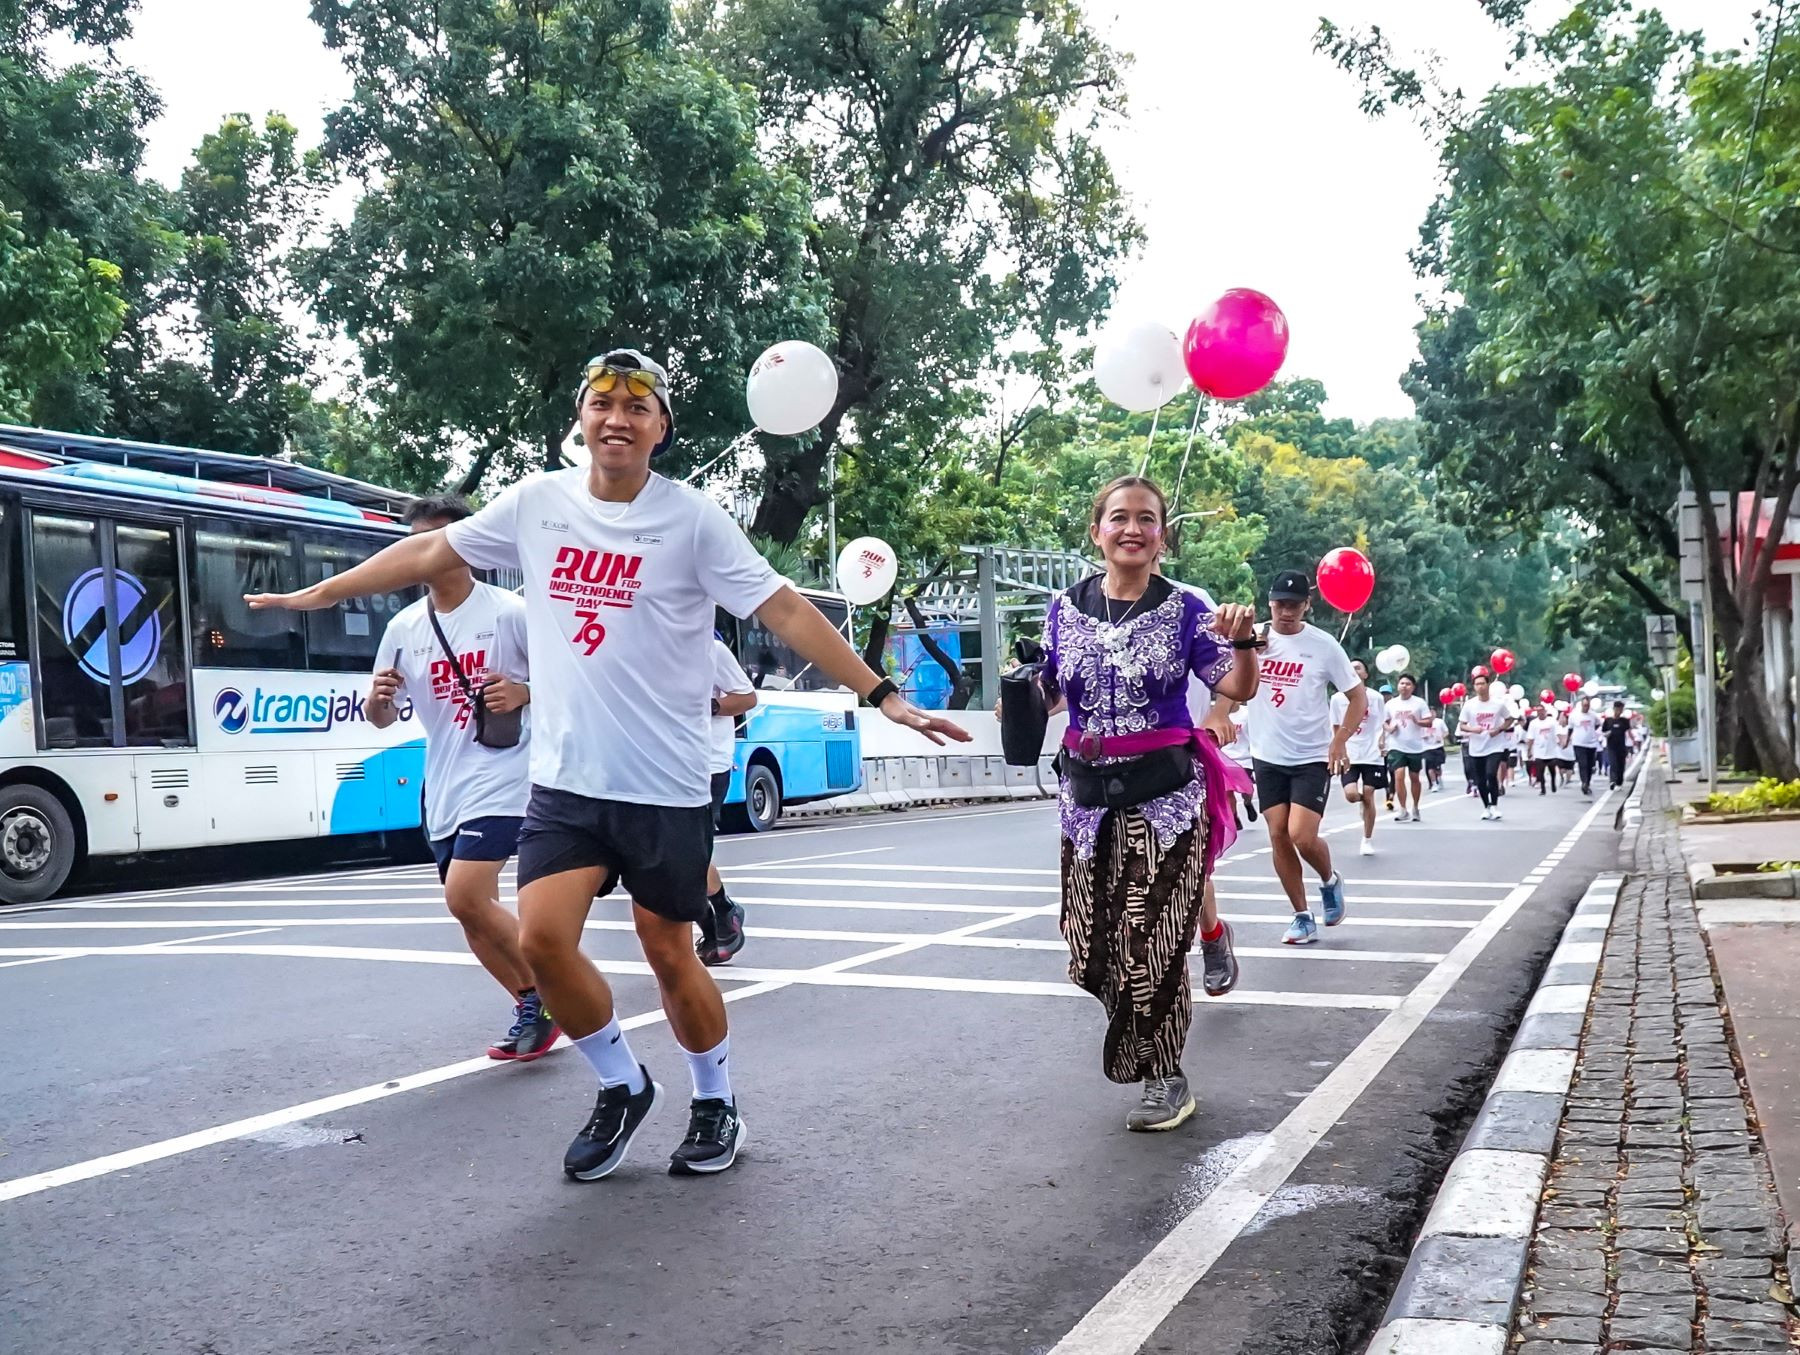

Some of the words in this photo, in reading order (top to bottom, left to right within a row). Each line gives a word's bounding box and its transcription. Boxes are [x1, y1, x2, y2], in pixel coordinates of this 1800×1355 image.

[551, 547, 642, 586] RUN
[861, 550, 886, 563] RUN
[549, 580, 636, 602] INDEPENDENCE
[621, 579, 642, 589] FOR
[576, 597, 602, 609] DAY
[572, 610, 606, 656] 79
[1261, 660, 1303, 677] RUN
[1271, 688, 1285, 708] 79
[253, 687, 413, 732] transjaka
[452, 698, 473, 730] 79
